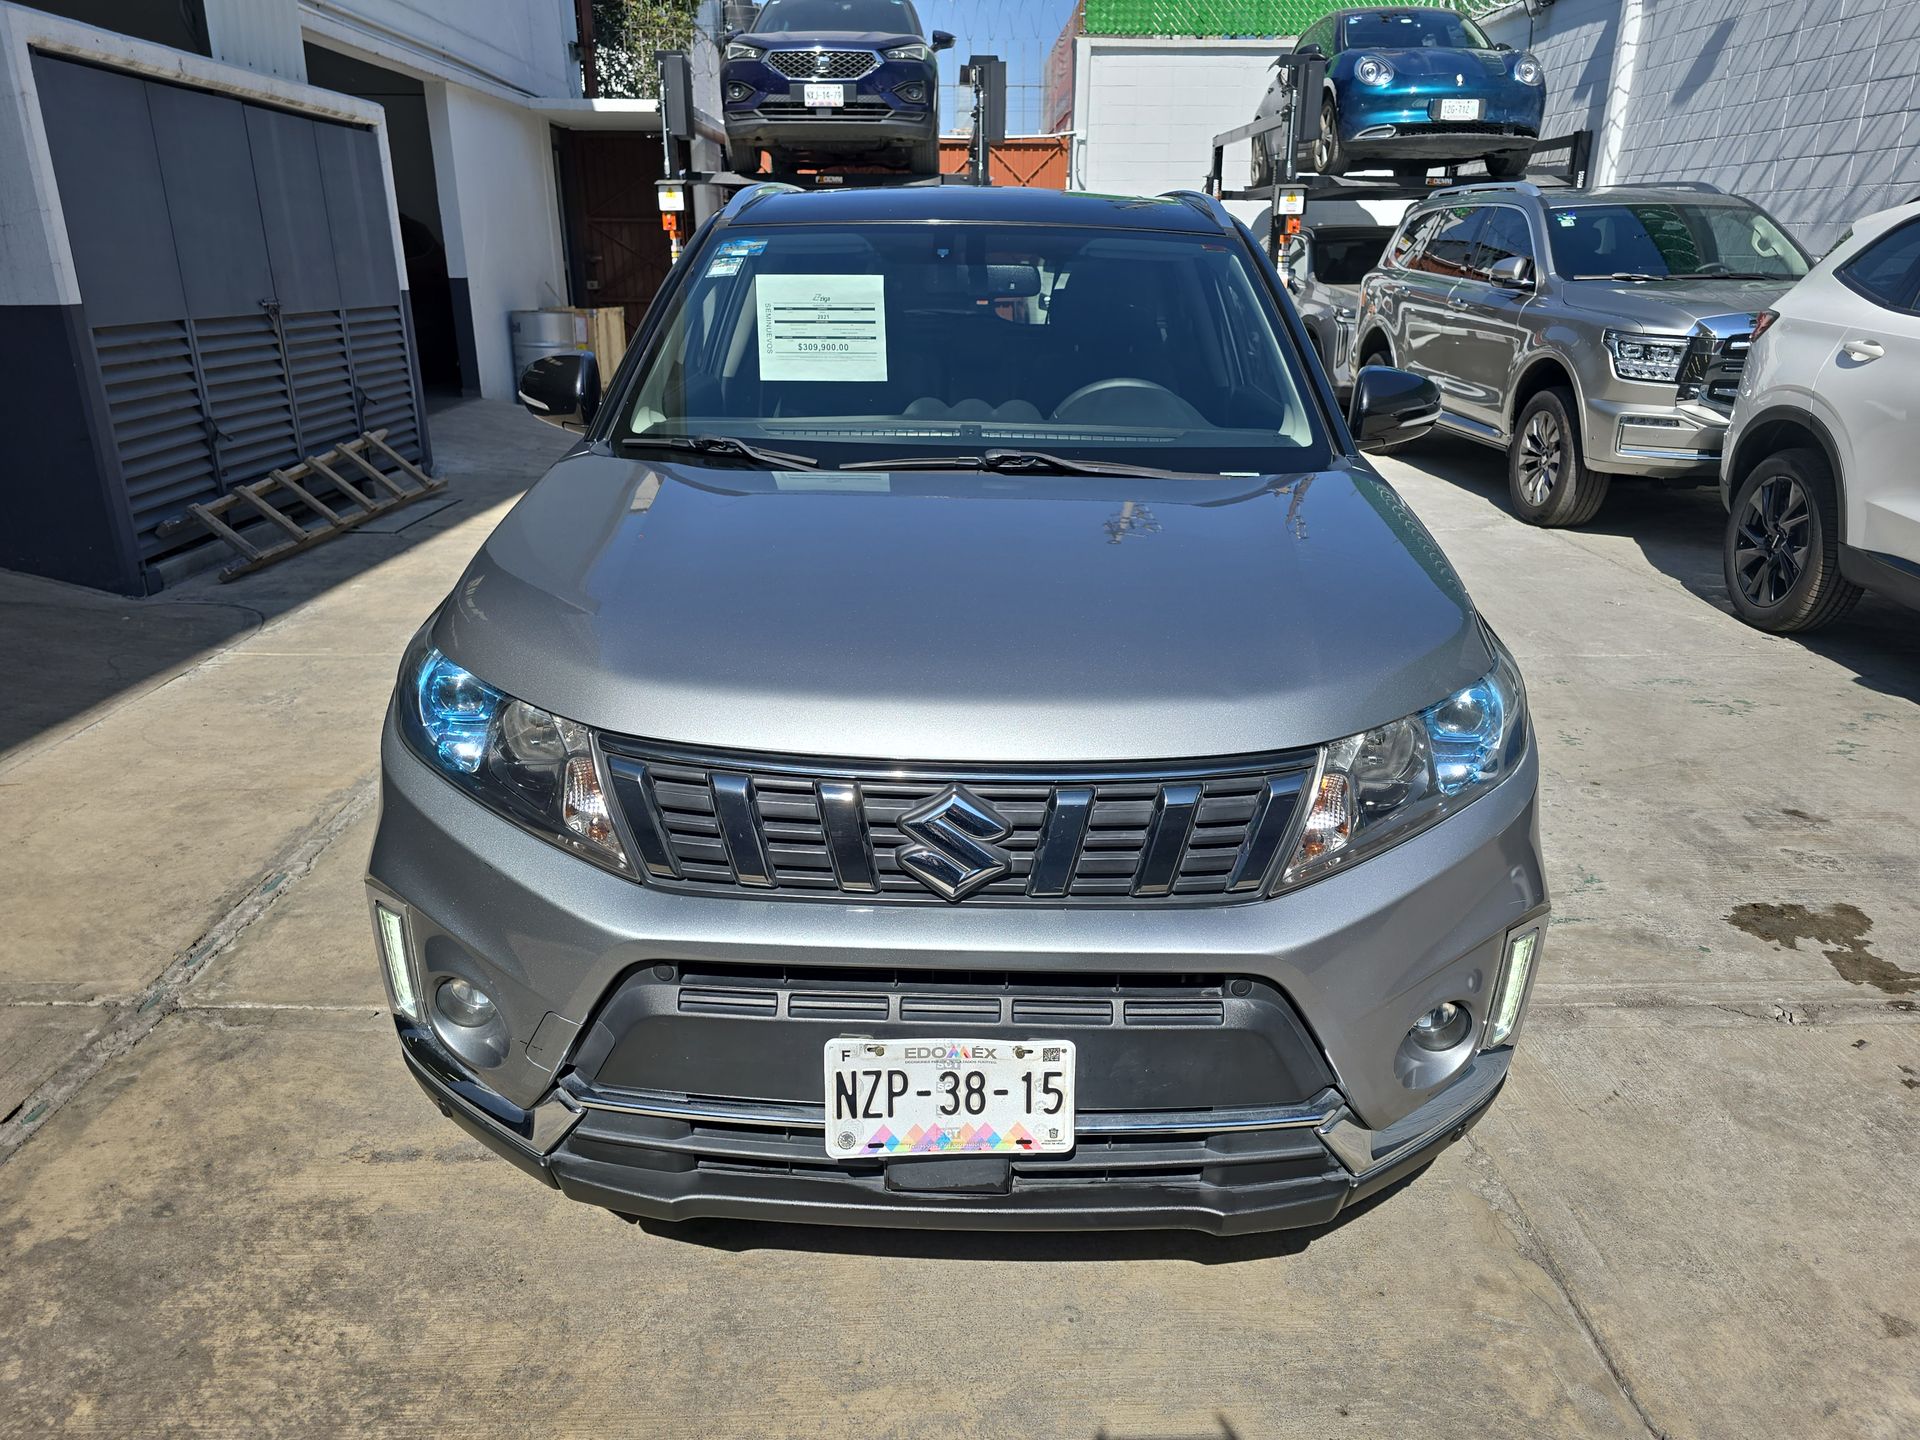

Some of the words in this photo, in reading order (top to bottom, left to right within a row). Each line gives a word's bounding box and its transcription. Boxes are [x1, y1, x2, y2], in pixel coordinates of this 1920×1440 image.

[765, 303, 773, 354] SEMINUEVOS
[798, 343, 849, 351] $309,900.00
[842, 1050, 851, 1062] F
[835, 1070, 1063, 1120] NZP-38-15
